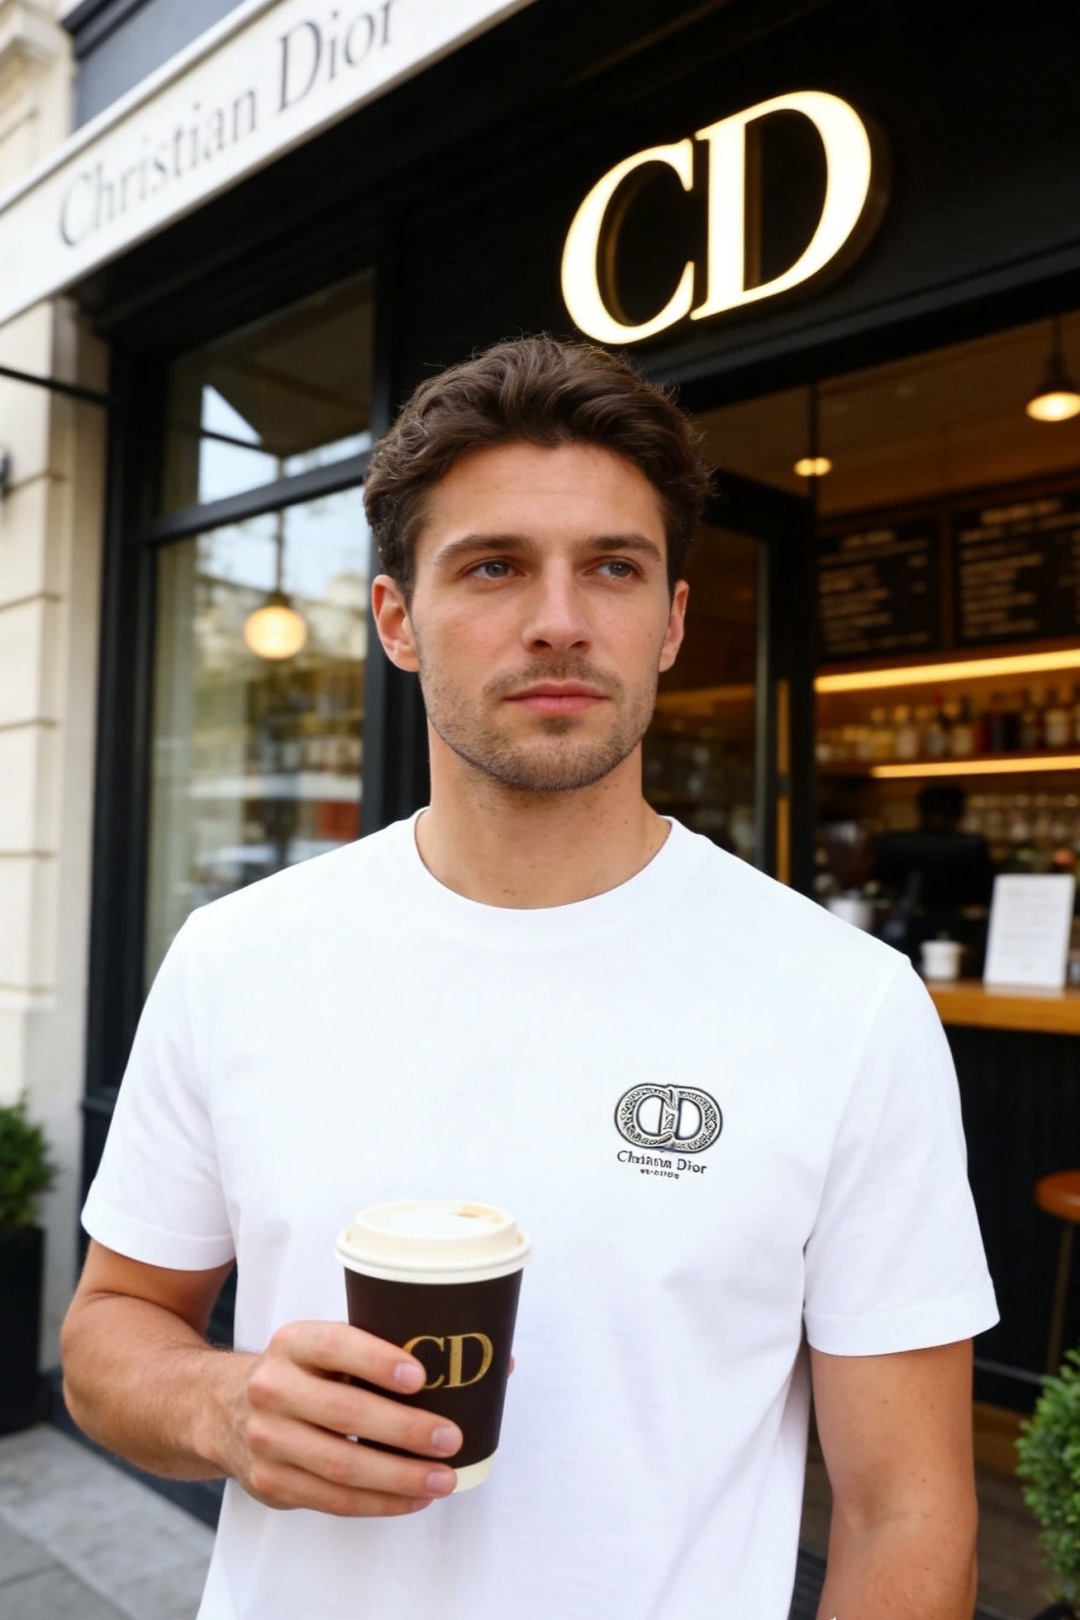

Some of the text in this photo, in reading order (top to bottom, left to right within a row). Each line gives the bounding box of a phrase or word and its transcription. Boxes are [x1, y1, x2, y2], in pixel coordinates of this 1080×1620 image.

[58, 0, 394, 248] Christian Dior
[560, 90, 872, 345] CD
[677, 1158, 707, 1174] Dior
[401, 1332, 493, 1389] CD
